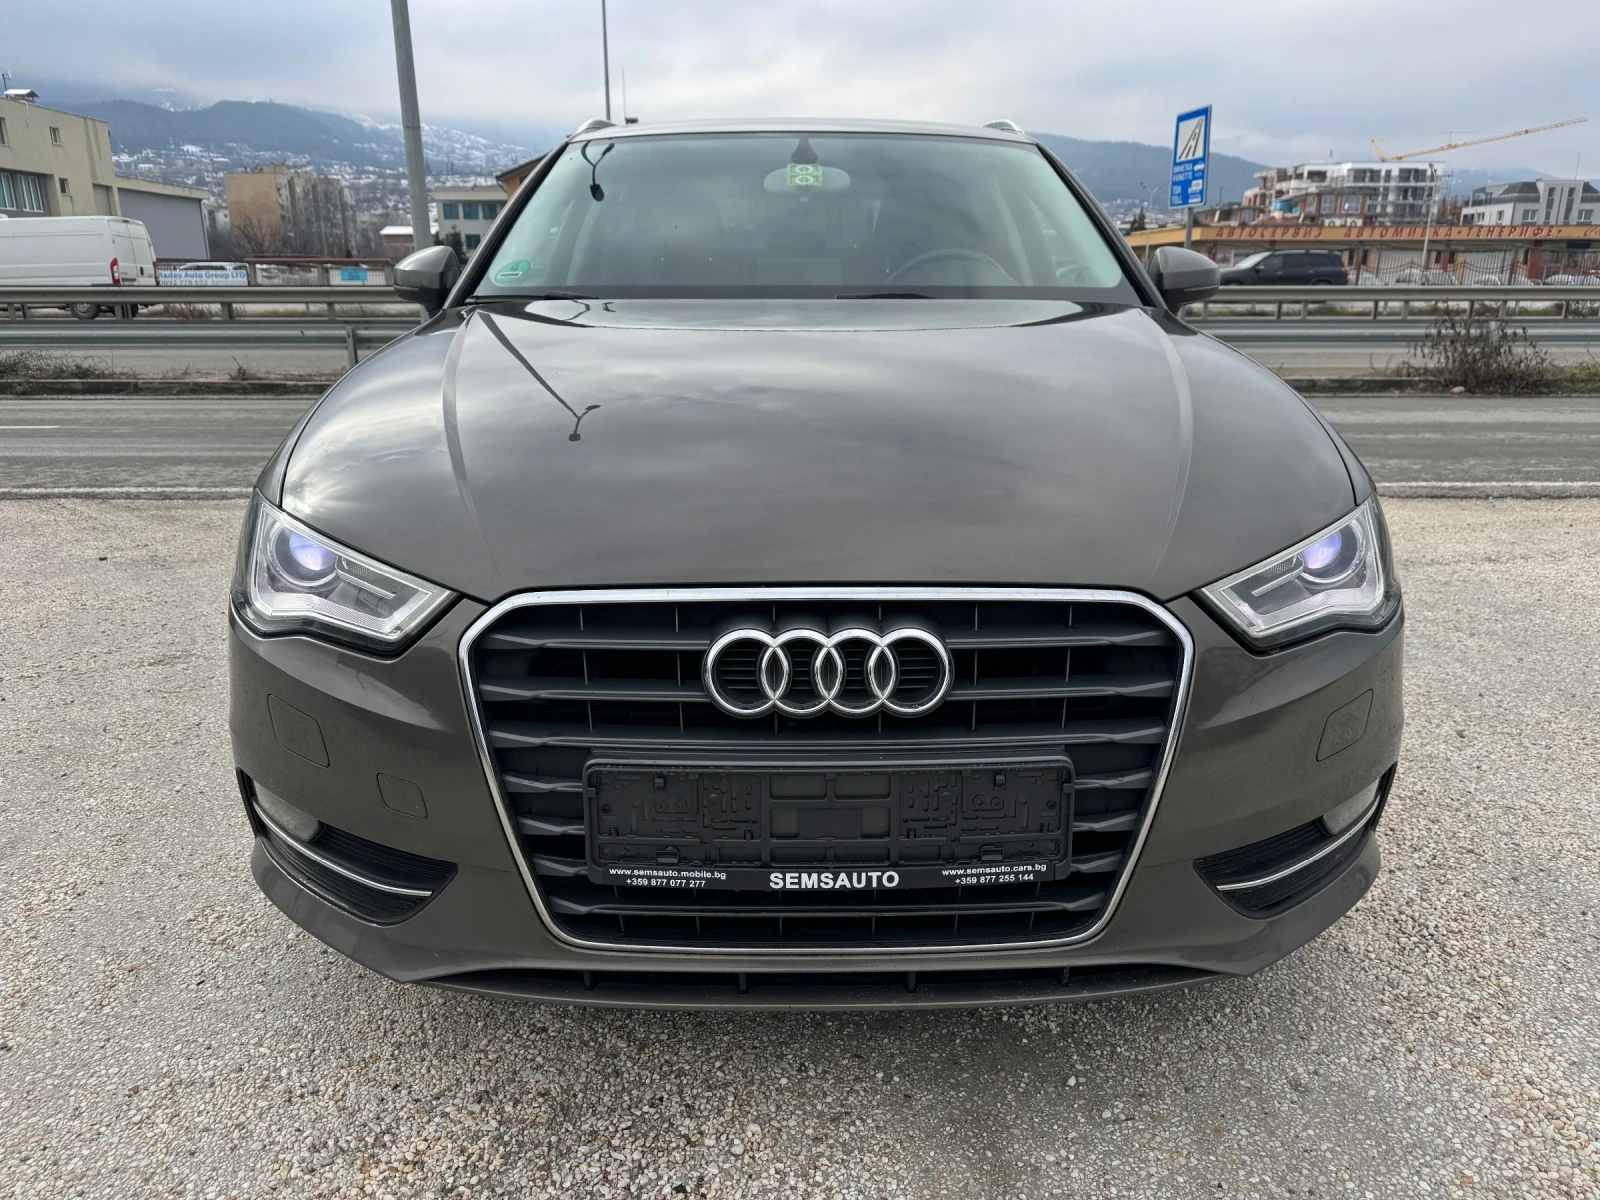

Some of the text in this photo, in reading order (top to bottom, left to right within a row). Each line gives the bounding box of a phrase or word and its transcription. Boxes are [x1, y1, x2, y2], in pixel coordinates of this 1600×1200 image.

[1216, 225, 1555, 239] АВТОСЕРВИЗ АВТОМИВКА ТЕНЕРИФЕ
[510, 260, 521, 271] 4
[184, 271, 203, 279] Auto
[205, 271, 230, 280] Group
[609, 868, 726, 880] www.semsauto.mobile.bg
[942, 864, 1047, 876] www.semsauto.cars.bg
[626, 878, 706, 888] +359 877 077 277
[769, 870, 899, 889] SEMSAUTO
[955, 873, 1034, 885] +359 877 255 144
